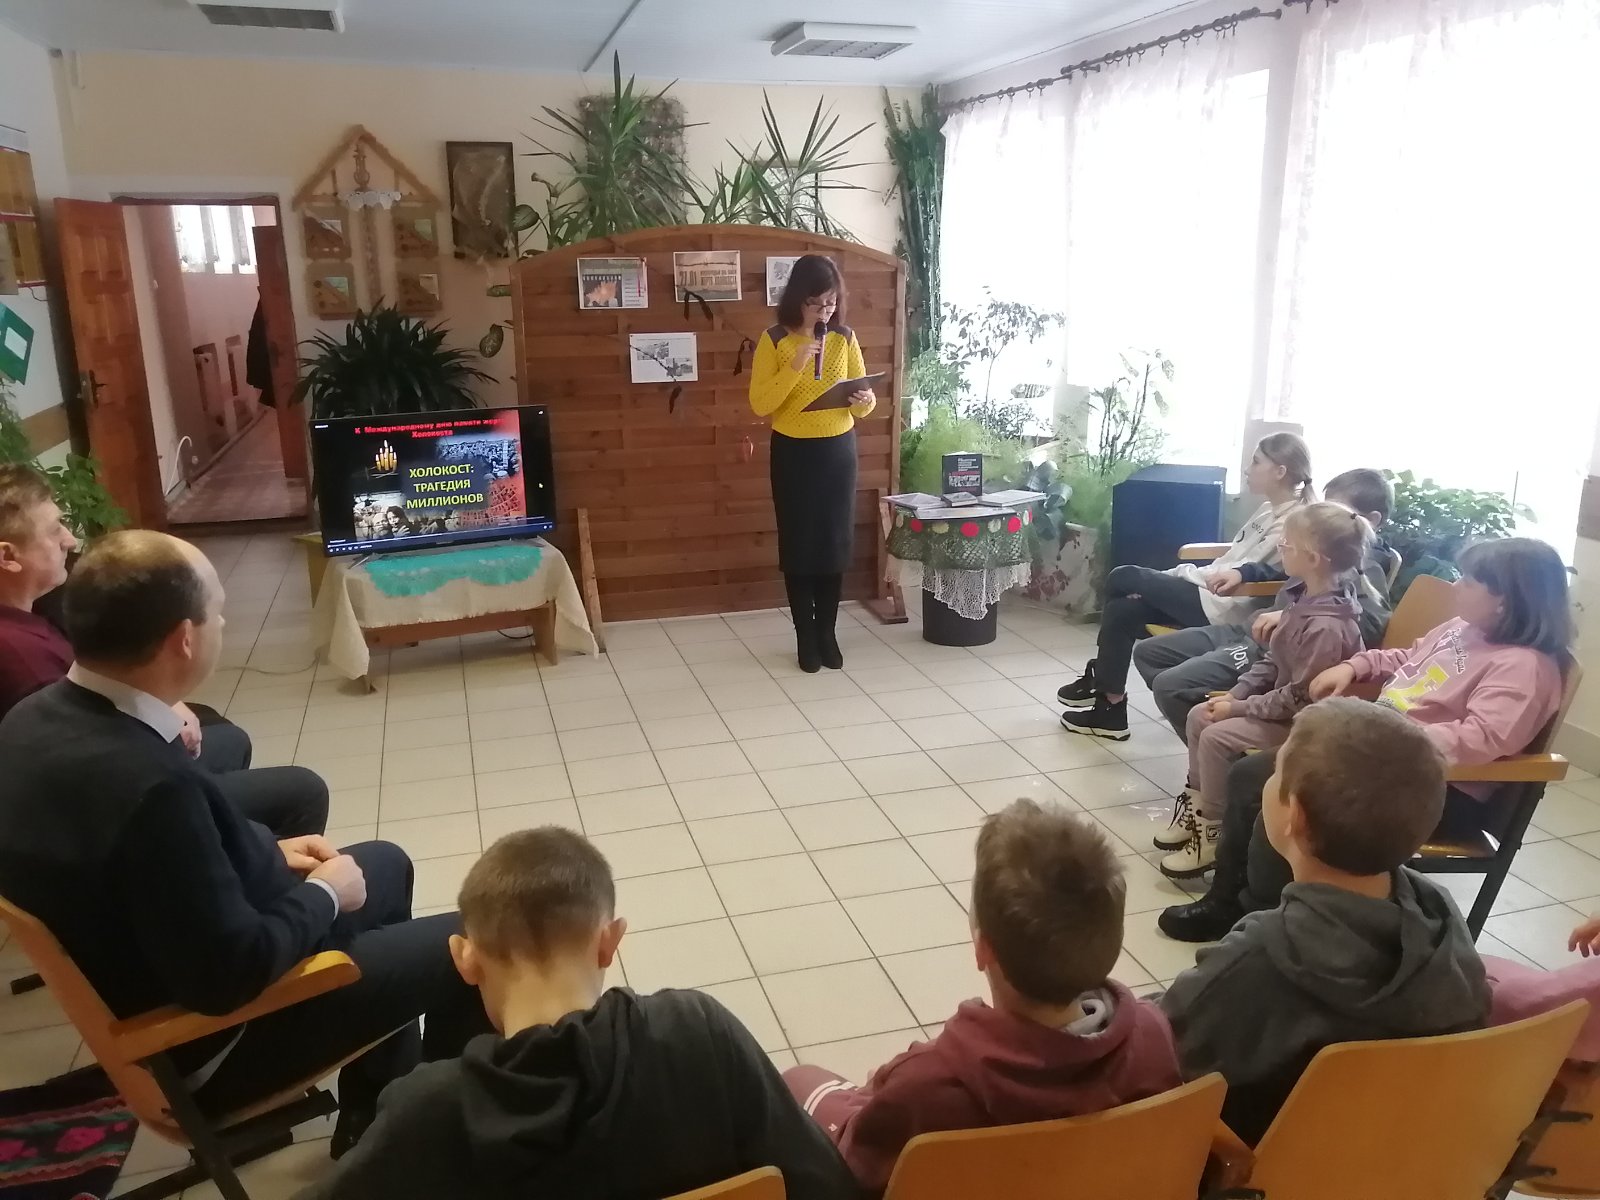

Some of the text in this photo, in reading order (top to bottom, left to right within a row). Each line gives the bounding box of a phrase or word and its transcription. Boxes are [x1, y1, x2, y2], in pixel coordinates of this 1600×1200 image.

[364, 422, 434, 434] Международному
[436, 421, 452, 429] дню
[453, 419, 481, 427] памяти
[412, 429, 454, 439] Холокоста
[409, 463, 475, 478] ХОЛОКОСТ:
[413, 479, 471, 493] ТРАГЕДИЯ
[406, 493, 484, 509] МИЛЛИОНОВ
